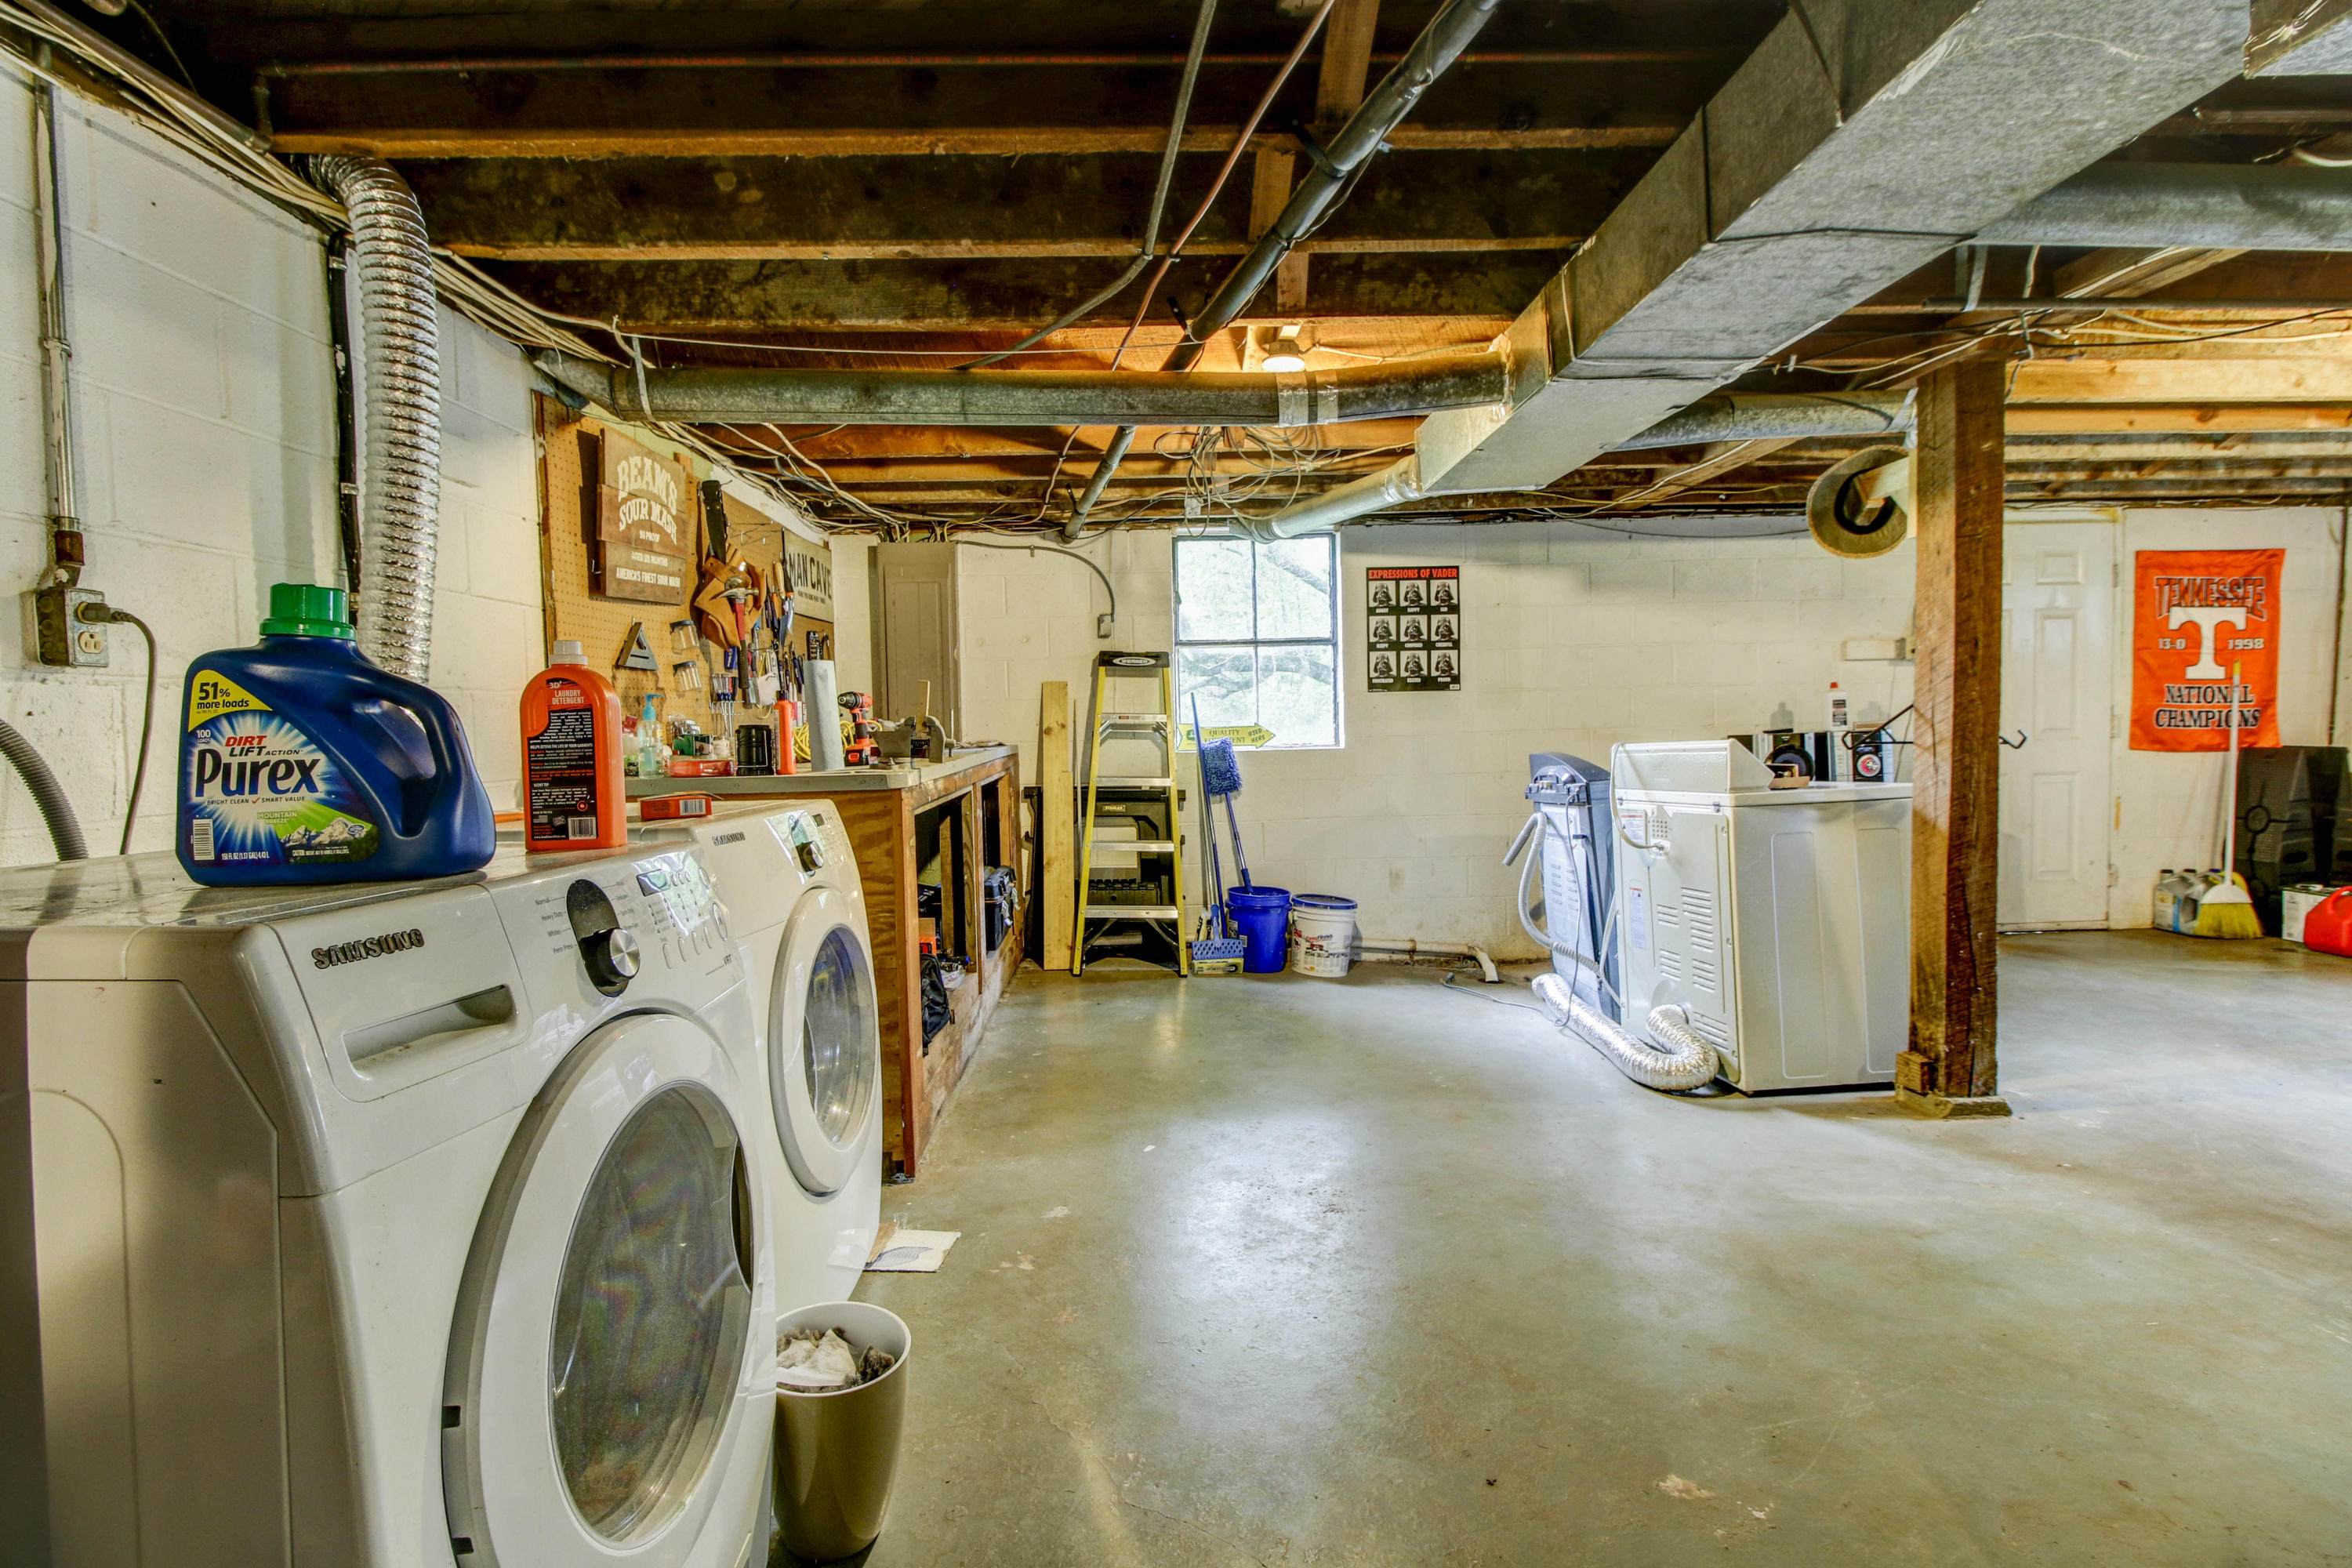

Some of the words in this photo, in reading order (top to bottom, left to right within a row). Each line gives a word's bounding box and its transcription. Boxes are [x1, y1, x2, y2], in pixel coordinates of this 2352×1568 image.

[617, 456, 677, 516] BEAM'S
[619, 498, 649, 532] SOUR
[651, 499, 677, 546] MASH
[646, 531, 660, 543] PROOF
[616, 568, 641, 582] AMERICA'S
[642, 572, 656, 583] FINEST
[657, 574, 668, 586] SOUR
[669, 576, 681, 588] MASH
[789, 553, 808, 587] MAN
[810, 557, 832, 601] CAVE
[1369, 569, 1418, 579] EXPRESSIONS
[1421, 568, 1430, 578] OF
[1432, 568, 1457, 578] VADER
[2154, 577, 2266, 621] TENNESSEE
[2158, 638, 2187, 650] 13-0
[2169, 606, 2247, 680] T
[2228, 638, 2264, 650] 1998
[198, 681, 230, 701] 51%
[223, 699, 249, 708] loads
[552, 696, 584, 705] DETERGENT
[2154, 708, 2262, 729] CHAMPIONS
[225, 735, 267, 746] DIRT
[1251, 735, 1265, 743] HERE
[229, 746, 267, 757] LIFT
[196, 749, 321, 797] Purex
[712, 832, 746, 846] SAMSUNG
[312, 928, 425, 969] SAMSUNG
